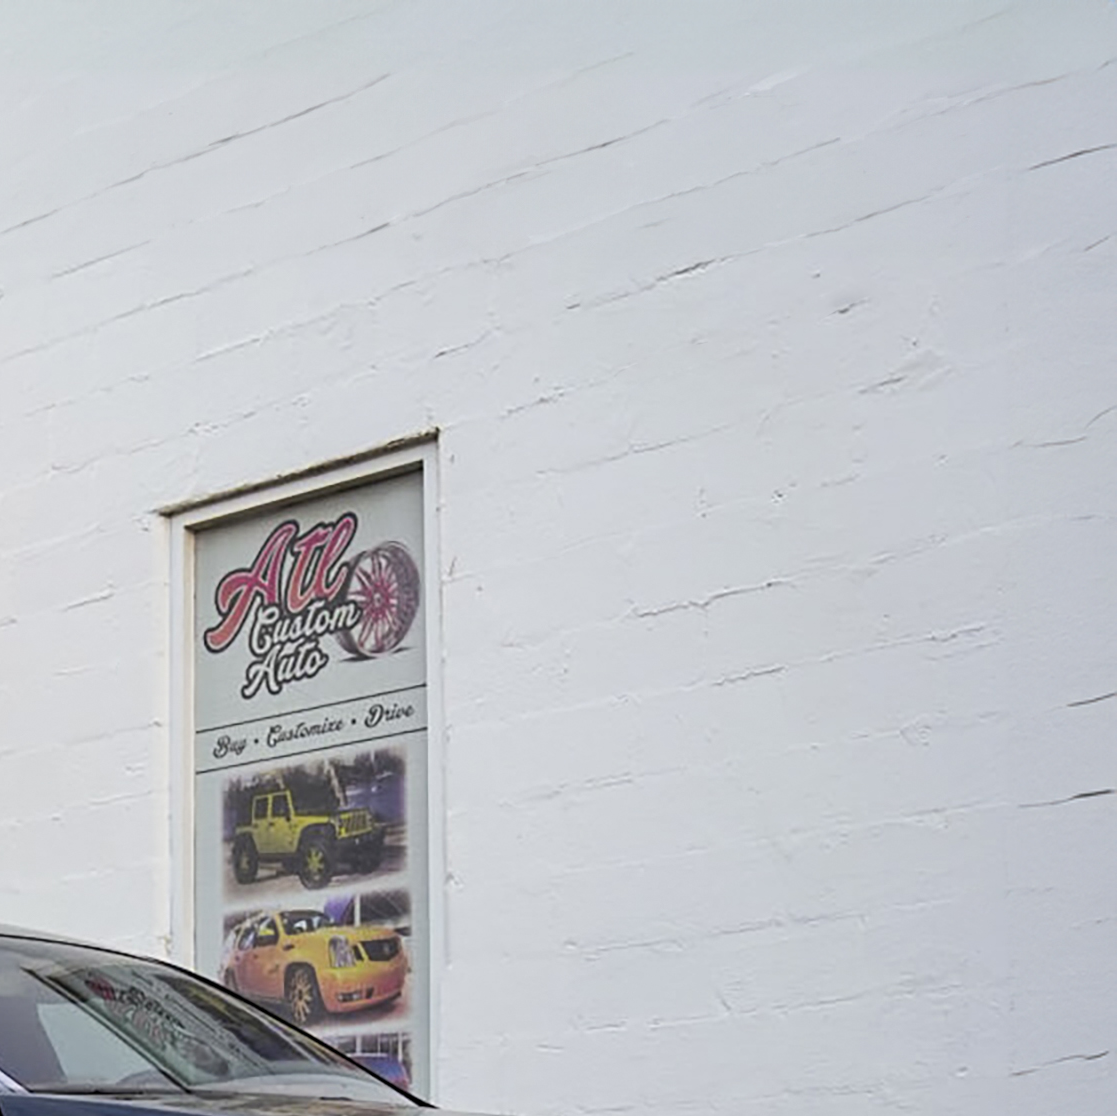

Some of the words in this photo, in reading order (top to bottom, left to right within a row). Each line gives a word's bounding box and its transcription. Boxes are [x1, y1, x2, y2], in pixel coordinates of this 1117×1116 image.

[249, 601, 363, 654] Custom
[241, 641, 329, 699] Auto
[213, 734, 247, 759] Buy
[267, 717, 345, 748] Customize
[365, 703, 415, 728] Drive
